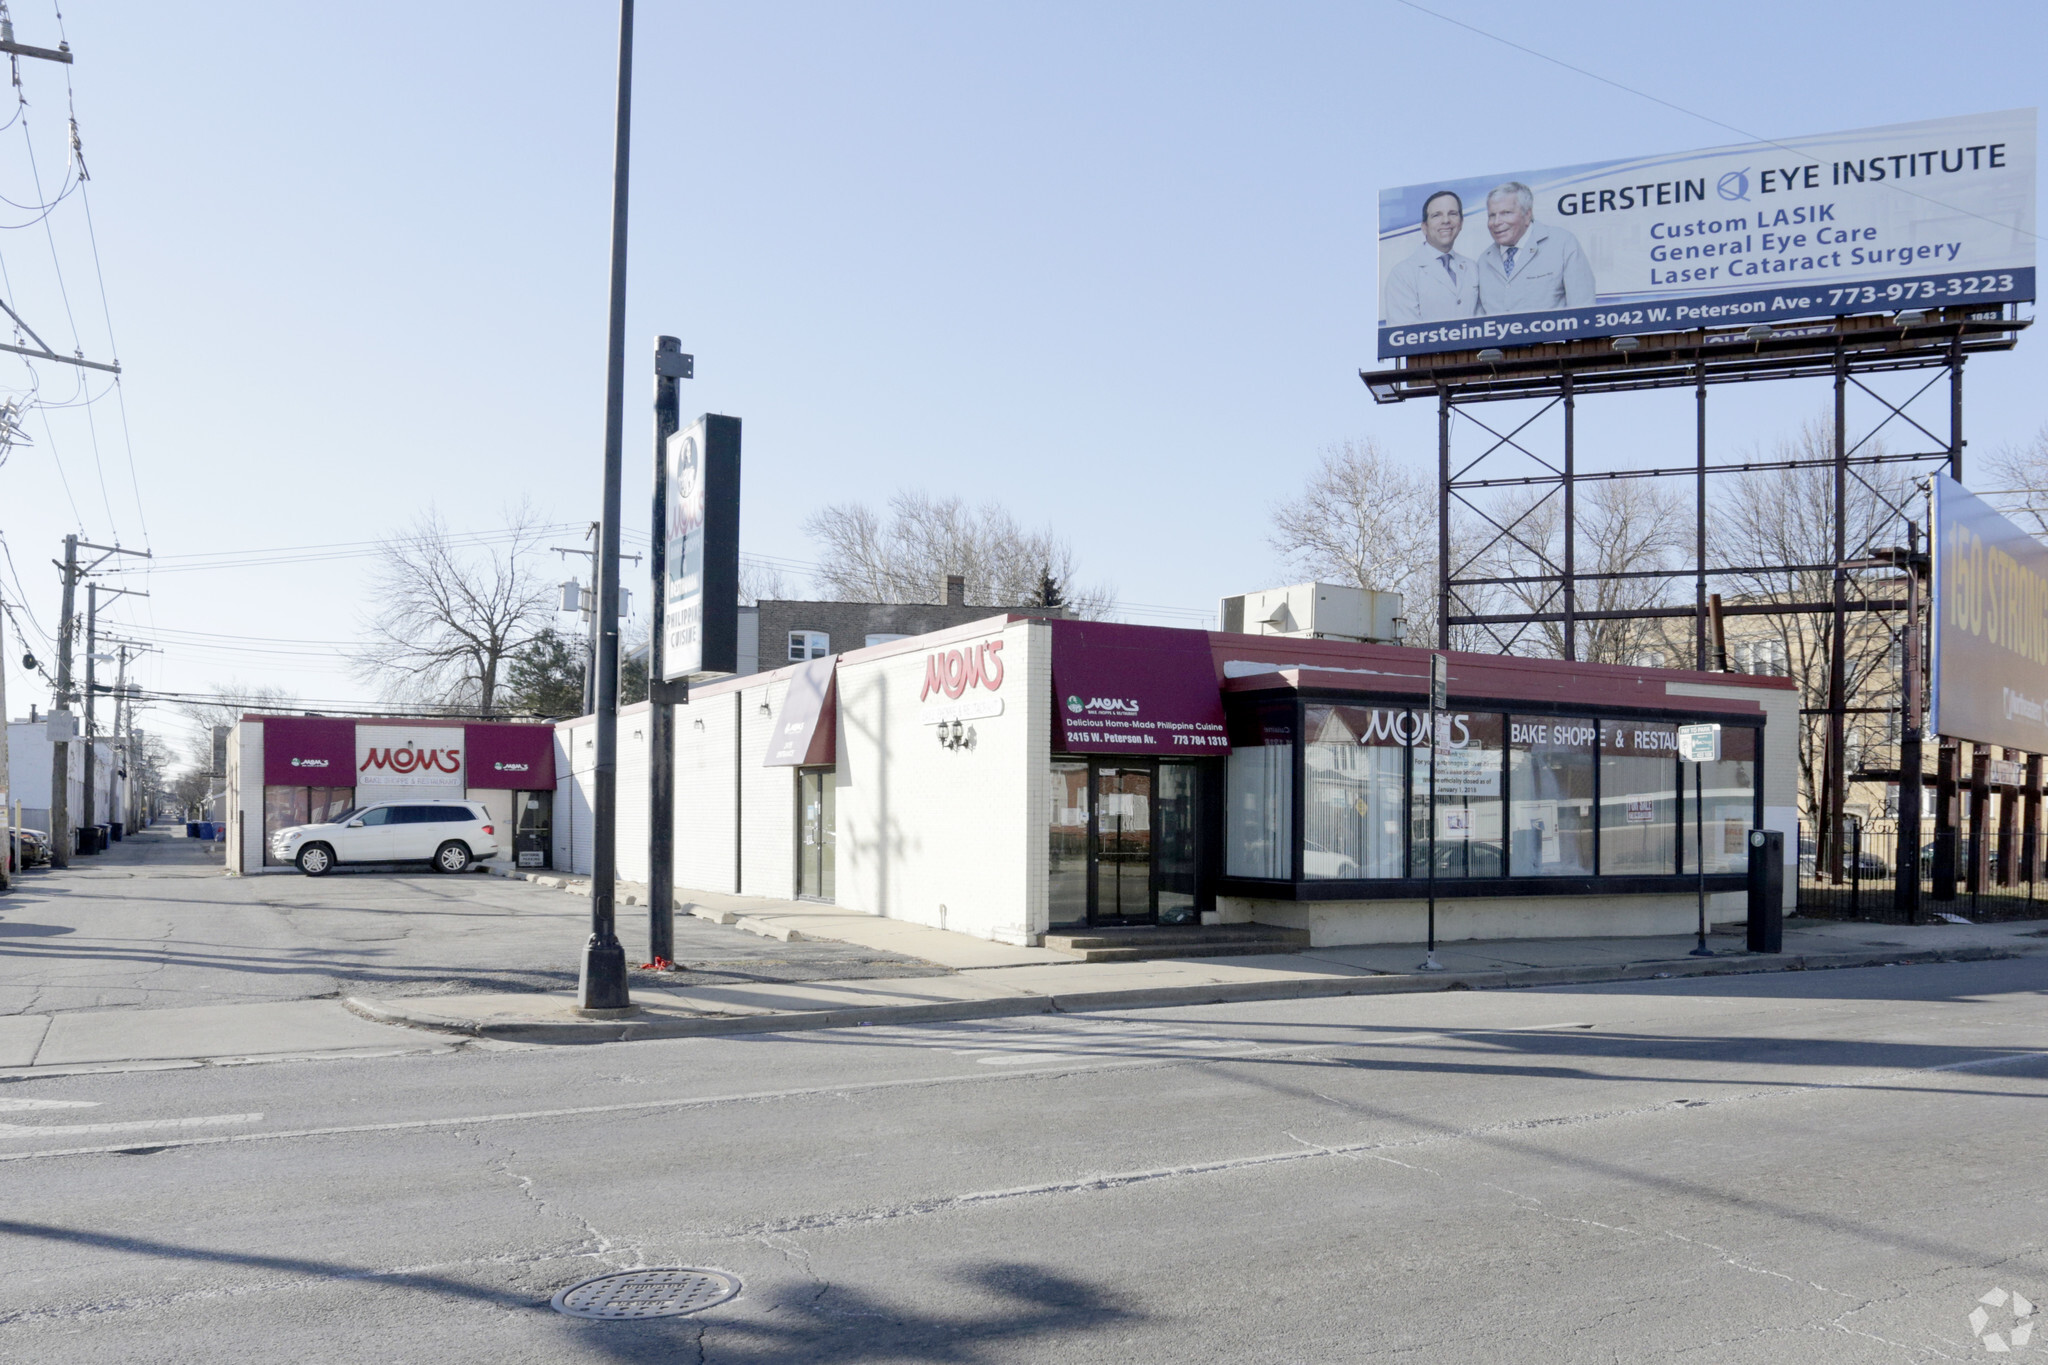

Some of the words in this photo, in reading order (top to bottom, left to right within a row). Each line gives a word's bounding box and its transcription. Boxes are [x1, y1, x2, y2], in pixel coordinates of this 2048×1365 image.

[1557, 178, 1705, 216] GERSTEIN
[1761, 164, 1819, 193] EYE
[1833, 143, 2006, 185] INSTITUTE
[1650, 217, 1747, 240] Custom
[1758, 203, 1835, 228] LASIK
[1650, 235, 1752, 262] General
[1762, 233, 1807, 253] Eye
[1816, 227, 1877, 245] Care
[1651, 265, 1719, 285] Laser
[1728, 250, 1841, 277] Cataract
[1851, 242, 1962, 265] Surgery
[1389, 316, 1578, 346] GersteinEye.com
[1595, 310, 1643, 327] 3042
[1648, 308, 1671, 322] W.
[1676, 299, 1766, 320] Peterson
[1771, 296, 1811, 311] Ave
[1828, 275, 2014, 306] 773-973-3223
[1950, 519, 1983, 636] 150
[1987, 544, 2048, 667] STRONG
[920, 640, 1004, 703] MOM'S
[1085, 697, 1140, 712] MOM'S
[1066, 718, 1104, 727] Delicious
[1105, 720, 1155, 728] Home-Made
[1157, 721, 1194, 731] Philippine
[1196, 722, 1223, 731] Cuisine
[1067, 732, 1089, 742] 2415
[1090, 732, 1102, 743] W.
[1104, 733, 1142, 744] Peterson
[1144, 734, 1157, 744] Av.
[1173, 735, 1189, 745] 773
[1190, 735, 1206, 745] 784
[1208, 736, 1228, 746] 1318
[1511, 723, 1547, 744] BAKE
[1553, 726, 1606, 747] SHOPPE
[1615, 729, 1624, 748] &
[359, 748, 460, 774] MOM'S
